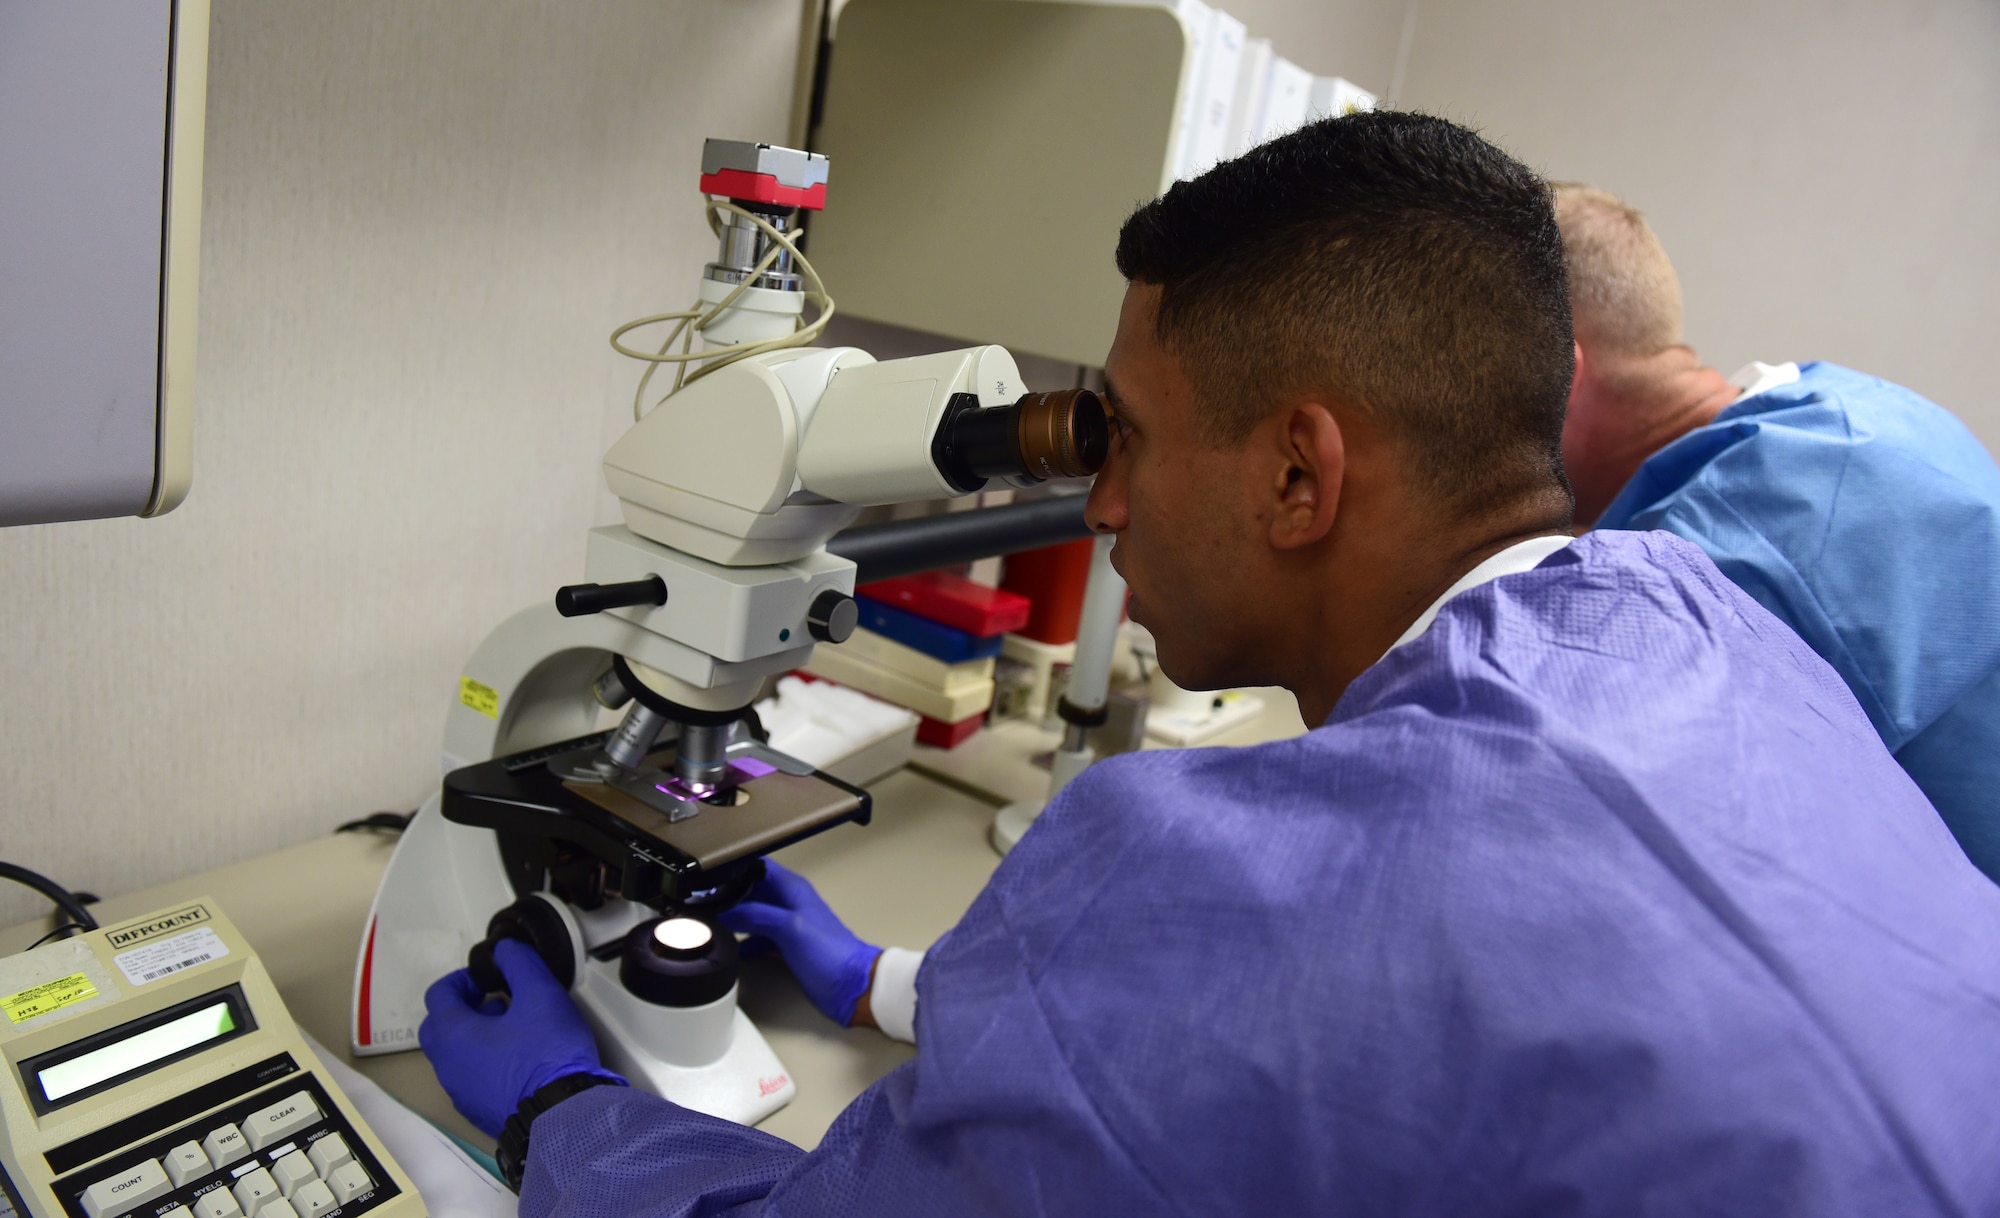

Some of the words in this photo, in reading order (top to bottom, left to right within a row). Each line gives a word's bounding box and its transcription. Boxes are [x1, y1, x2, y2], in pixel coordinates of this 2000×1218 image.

[113, 909, 200, 944] DIFFCOUNT
[372, 1026, 416, 1044] LEICA
[256, 1062, 288, 1079] CONTRAST
[269, 1106, 296, 1122] CLEAR
[218, 1131, 239, 1145] WBC
[306, 1128, 329, 1143] NRBC
[184, 1152, 195, 1160] %
[111, 1174, 143, 1194] COUNT
[193, 1180, 223, 1198] MYELO
[357, 1190, 375, 1204] SEG
[155, 1200, 180, 1216] META
